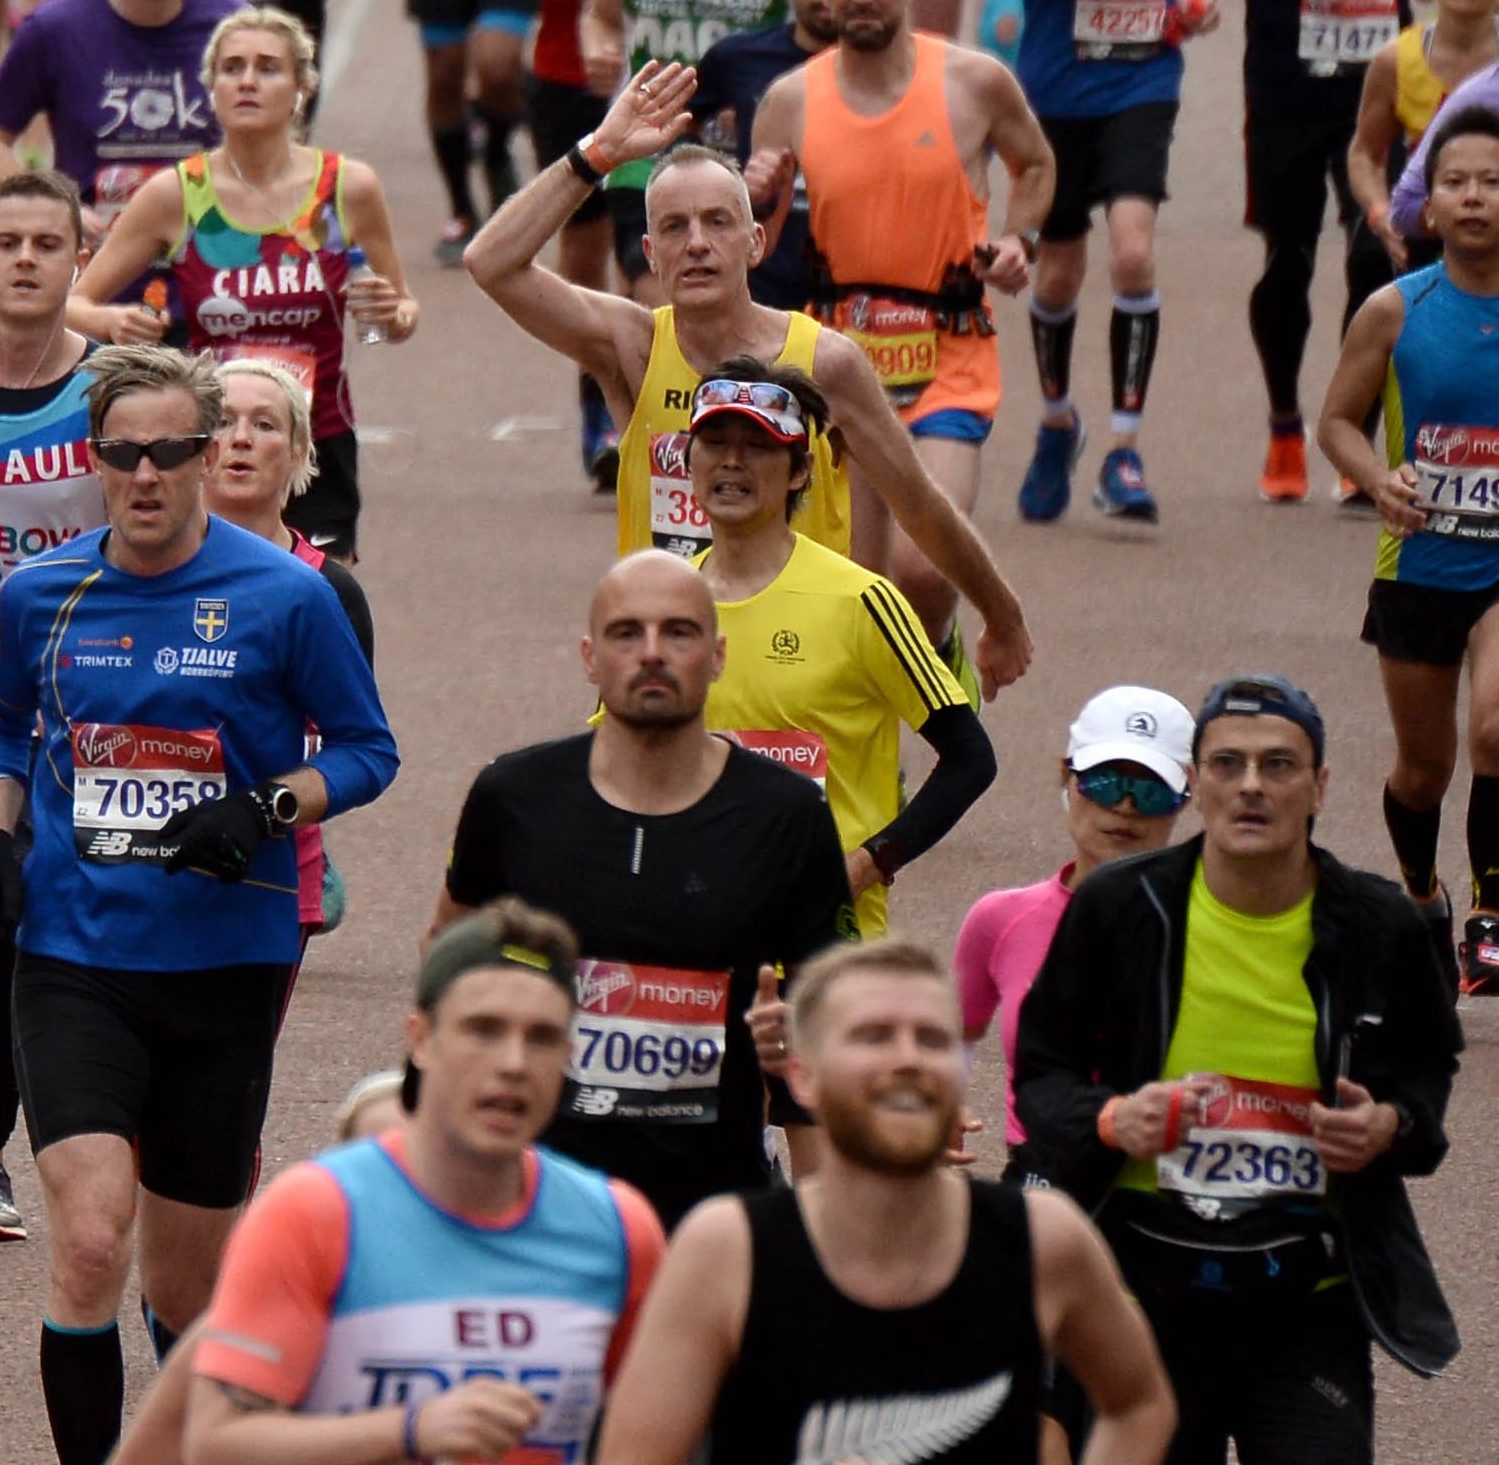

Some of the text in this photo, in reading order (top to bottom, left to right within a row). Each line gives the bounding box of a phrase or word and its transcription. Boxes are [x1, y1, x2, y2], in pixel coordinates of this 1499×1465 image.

[213, 261, 324, 298] CIARA
[202, 308, 321, 328] mencap
[74, 655, 133, 668] TRIMTEX
[182, 648, 238, 668] TJALVE
[80, 724, 215, 765] Virgin money
[750, 747, 820, 766] money
[132, 846, 157, 857] new
[576, 961, 724, 1012] Virgin money
[578, 1028, 719, 1078] 70699
[617, 1107, 642, 1116] new
[649, 1105, 703, 1117] balance
[1237, 1092, 1309, 1116] mone
[1182, 1140, 1319, 1190] 72363
[457, 1310, 535, 1347] ED
